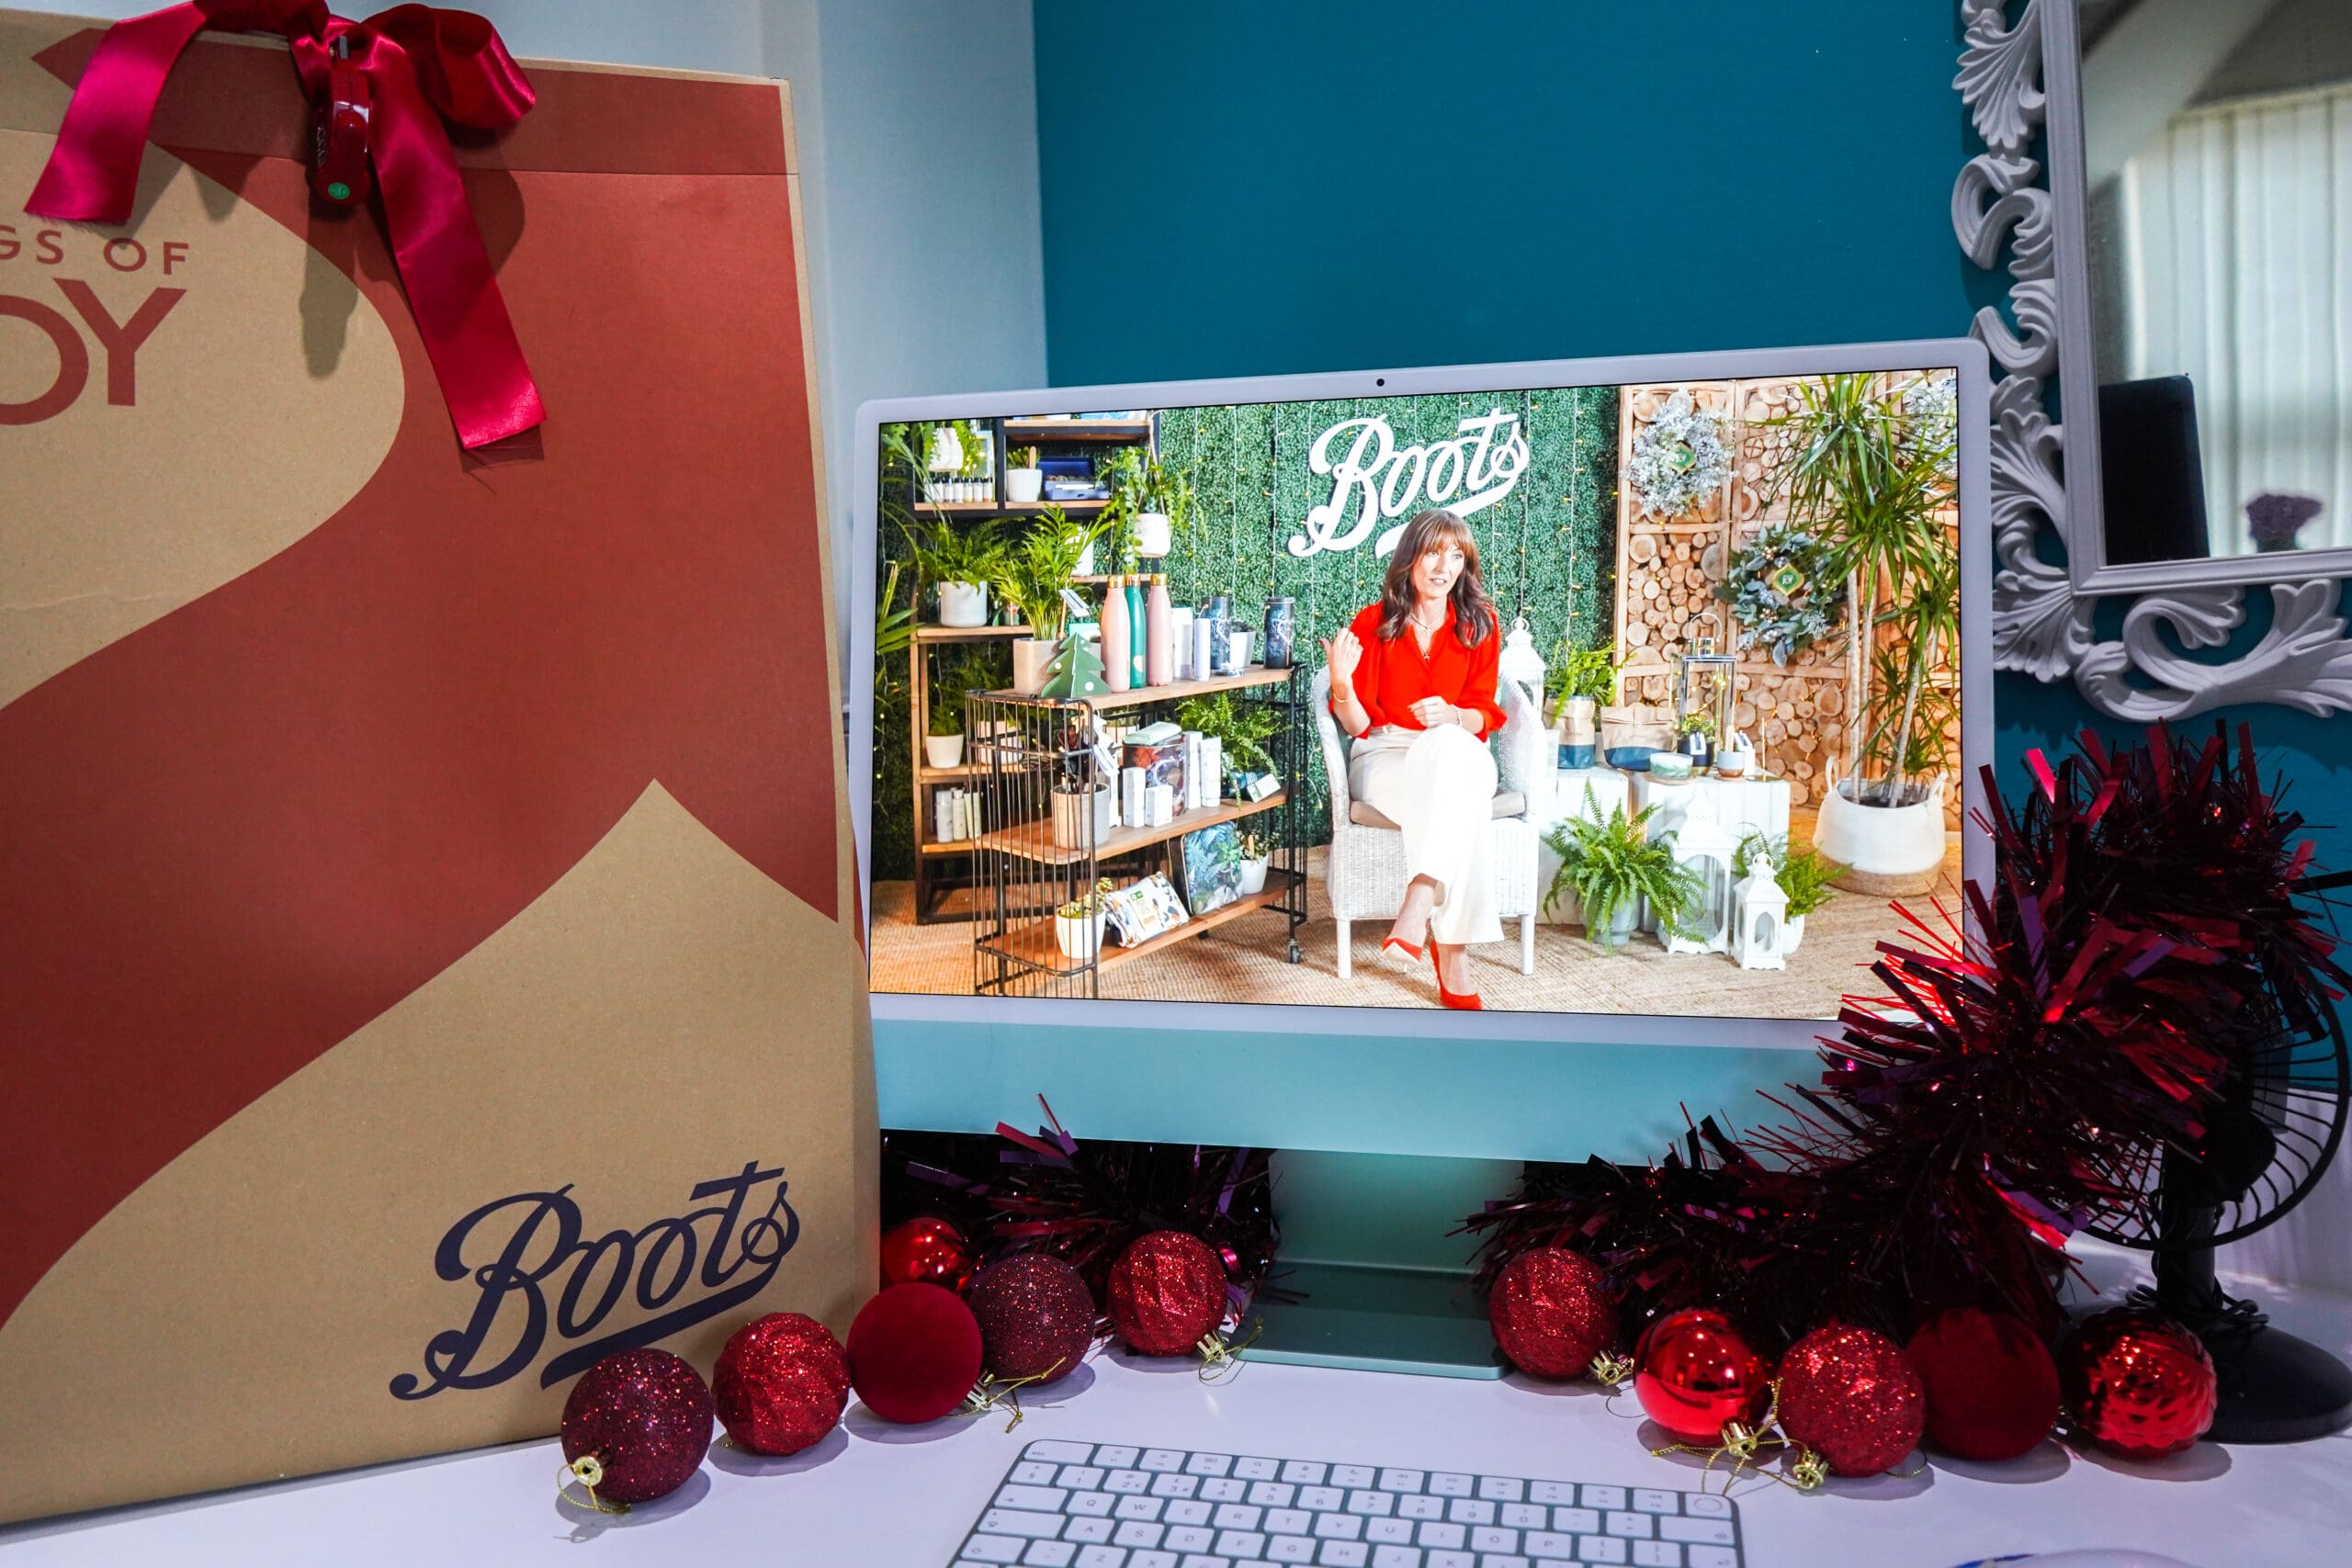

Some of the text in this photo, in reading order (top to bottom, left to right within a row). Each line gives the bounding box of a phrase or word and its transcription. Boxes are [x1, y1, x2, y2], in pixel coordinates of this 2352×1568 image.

[103, 237, 189, 276] OF
[1288, 408, 1530, 558] Boots
[390, 1160, 799, 1400] Boots
